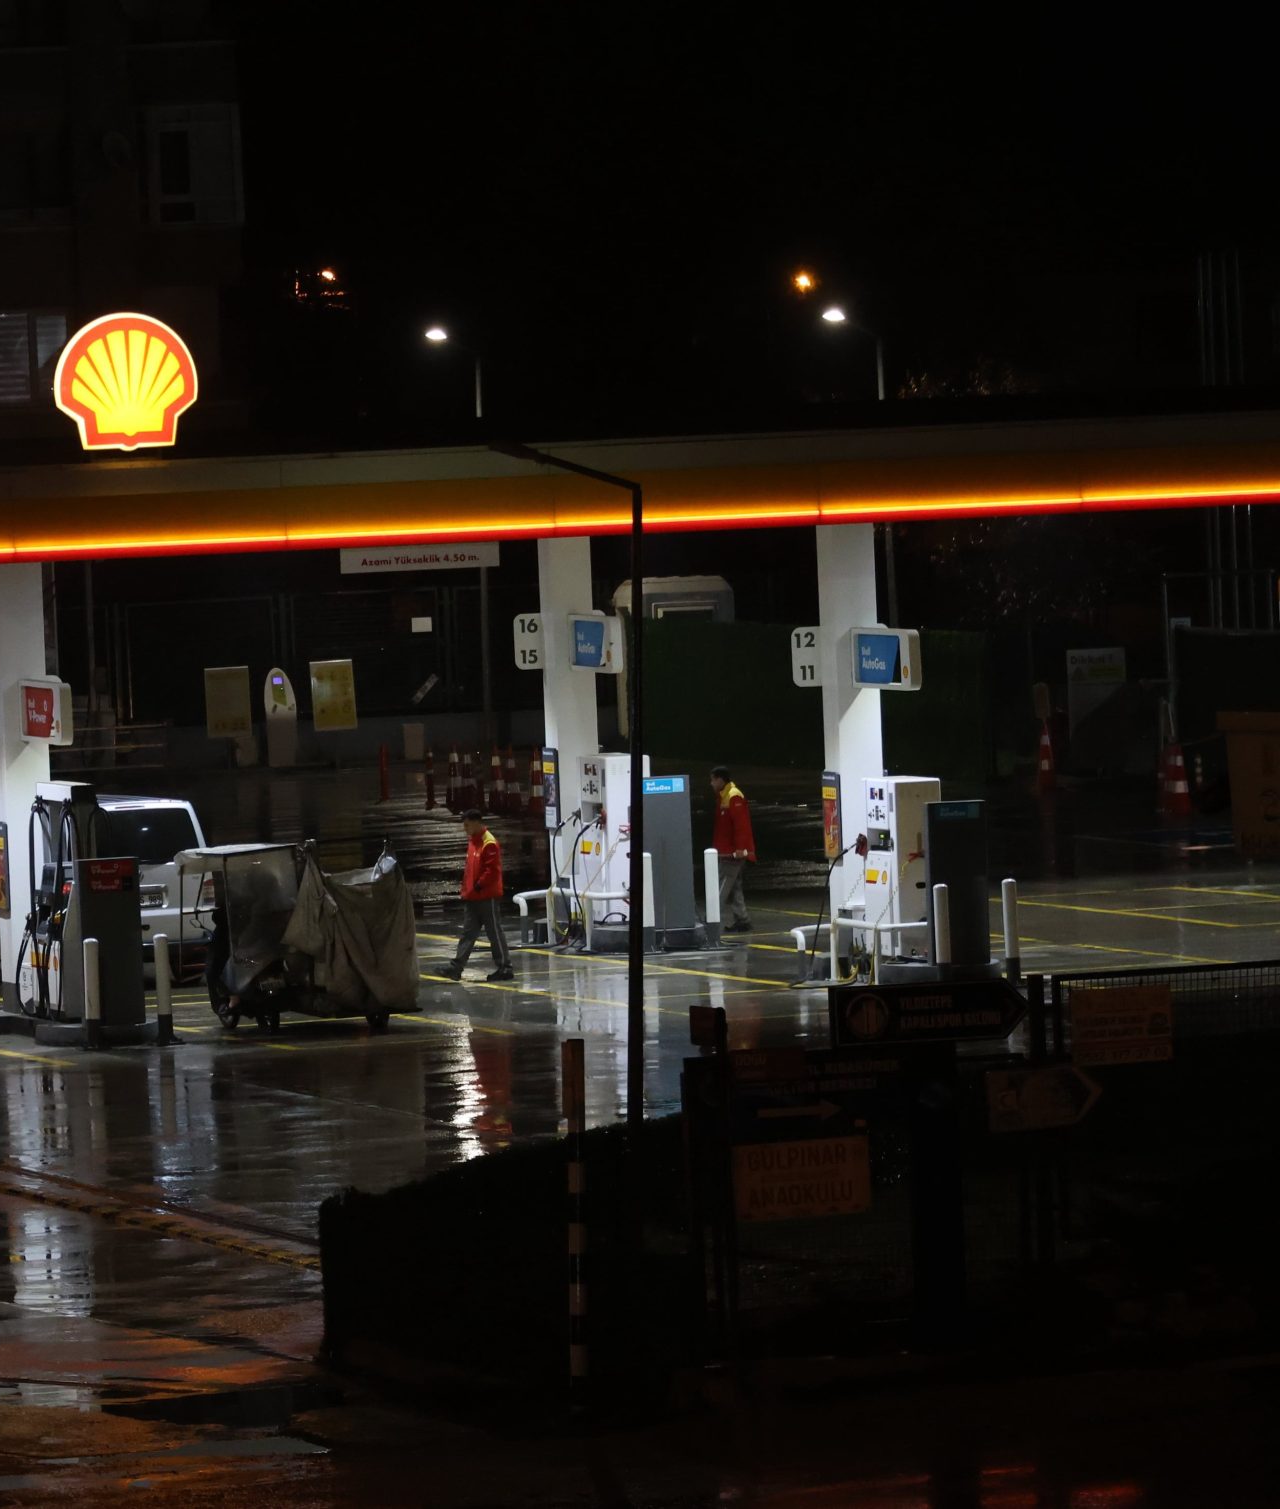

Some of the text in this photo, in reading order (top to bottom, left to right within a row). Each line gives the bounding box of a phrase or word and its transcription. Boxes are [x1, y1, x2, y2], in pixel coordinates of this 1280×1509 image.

[361, 558, 392, 567] Azami
[394, 554, 440, 565] Yükseklik
[443, 553, 466, 563] 4.50
[519, 618, 538, 633] 16
[794, 631, 815, 648] 12
[520, 649, 538, 664] 15
[800, 665, 815, 680] 11
[749, 1179, 854, 1209] ANAOKULU
